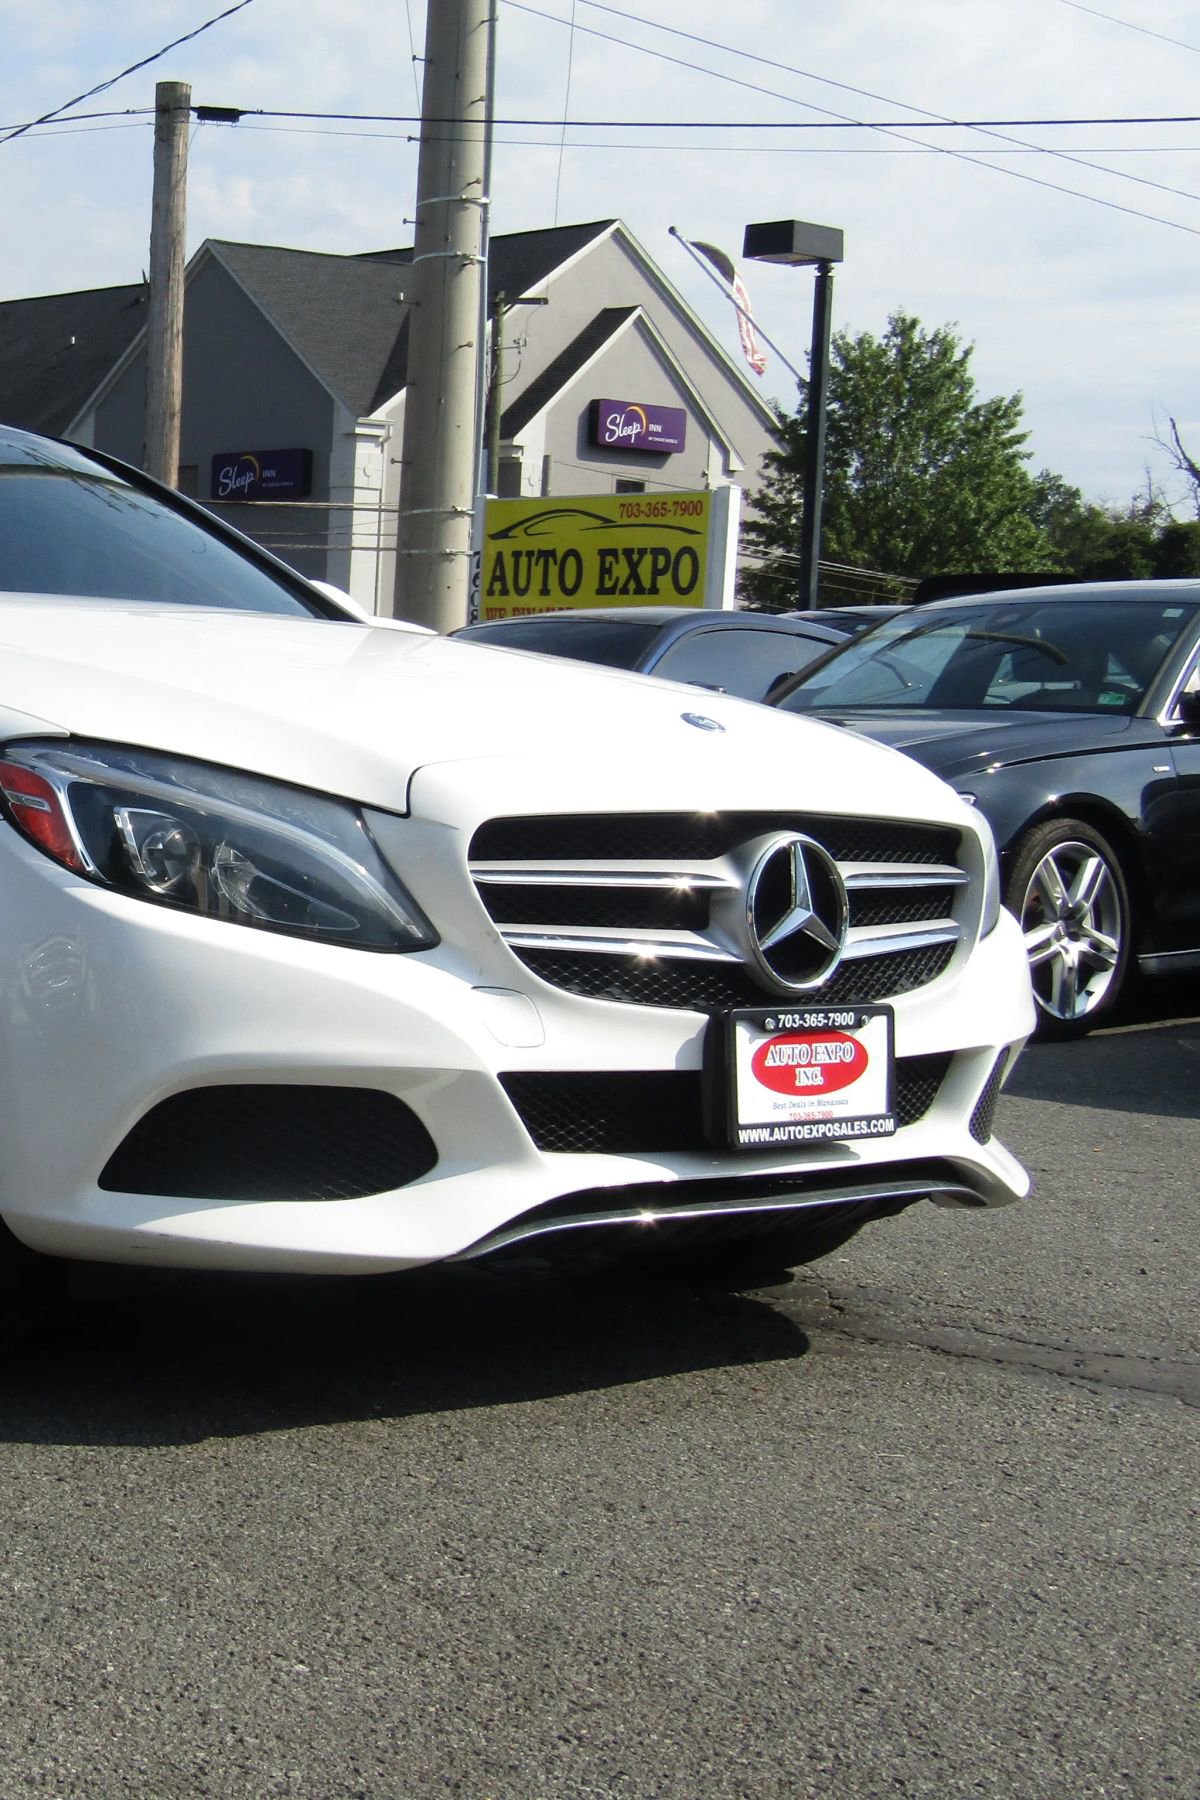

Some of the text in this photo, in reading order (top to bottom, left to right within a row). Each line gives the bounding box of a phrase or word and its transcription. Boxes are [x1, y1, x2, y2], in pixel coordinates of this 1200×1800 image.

[605, 413, 662, 444] Sleep INN
[218, 464, 276, 496] Sleep INN
[619, 500, 704, 519] 703-365-7900
[486, 545, 700, 596] AUTO EXPO
[777, 1012, 855, 1028] 703-365-7900
[764, 1041, 855, 1067] AUTO EXPO
[795, 1067, 824, 1086] INC.
[772, 1102, 787, 1110] Best
[738, 1118, 895, 1144] WWW.AUTOEXPOSALES.COM
